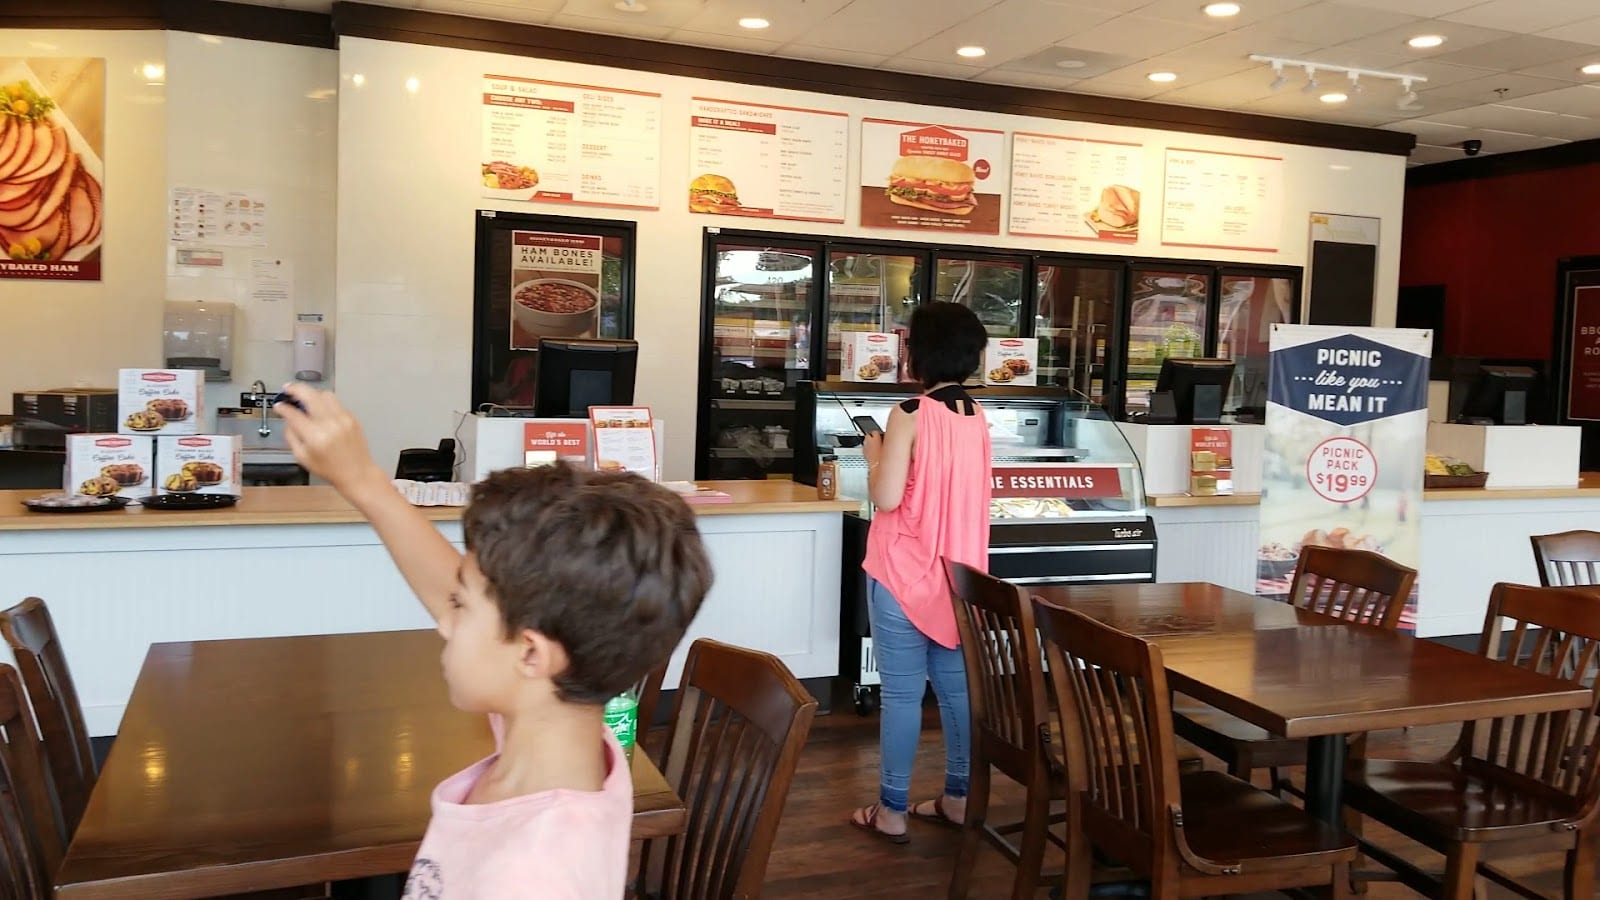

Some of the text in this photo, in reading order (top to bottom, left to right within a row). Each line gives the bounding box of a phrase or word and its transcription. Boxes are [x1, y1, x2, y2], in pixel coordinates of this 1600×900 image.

[902, 135, 967, 147] THE HONEYBAKED
[522, 246, 593, 258] HAM BONES
[521, 255, 593, 267] AVAILABLE!
[50, 264, 79, 272] HAM
[1317, 348, 1381, 367] PICNIC
[1314, 370, 1381, 393] like you
[1308, 394, 1388, 413] MEAN IT
[1322, 447, 1364, 459] PICNIC
[1327, 459, 1359, 471] PACK
[1010, 476, 1094, 489] ESSENTIALS
